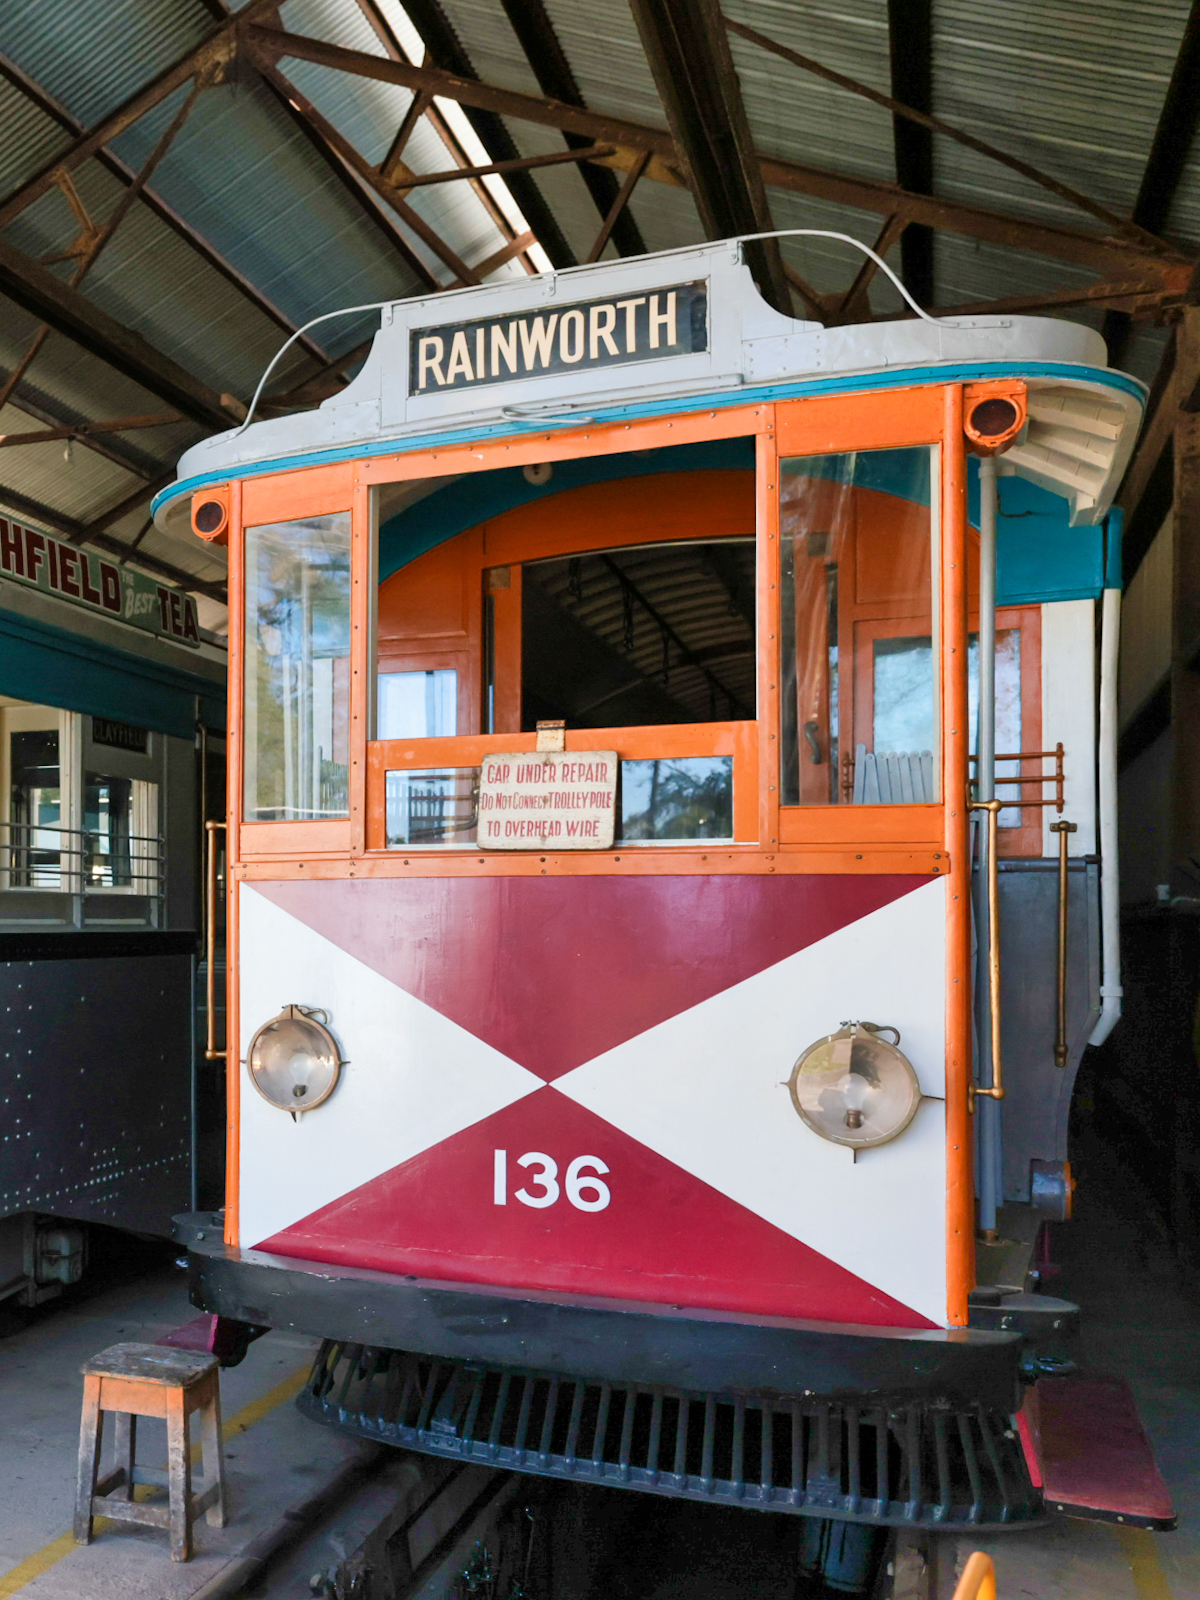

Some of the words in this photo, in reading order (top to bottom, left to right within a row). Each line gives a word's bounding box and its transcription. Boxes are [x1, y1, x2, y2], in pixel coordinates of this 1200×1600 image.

[418, 291, 677, 389] RAINWORTH
[125, 588, 156, 619] BEST
[156, 584, 199, 643] TEA
[487, 764, 511, 784] CAR
[516, 763, 557, 784] UNDER
[562, 762, 608, 783] REPAIR
[590, 791, 612, 809] POLE
[487, 820, 501, 837] TO
[505, 820, 561, 838] OVERHEAD
[566, 820, 600, 837] WIRE
[494, 1149, 611, 1213] 136
